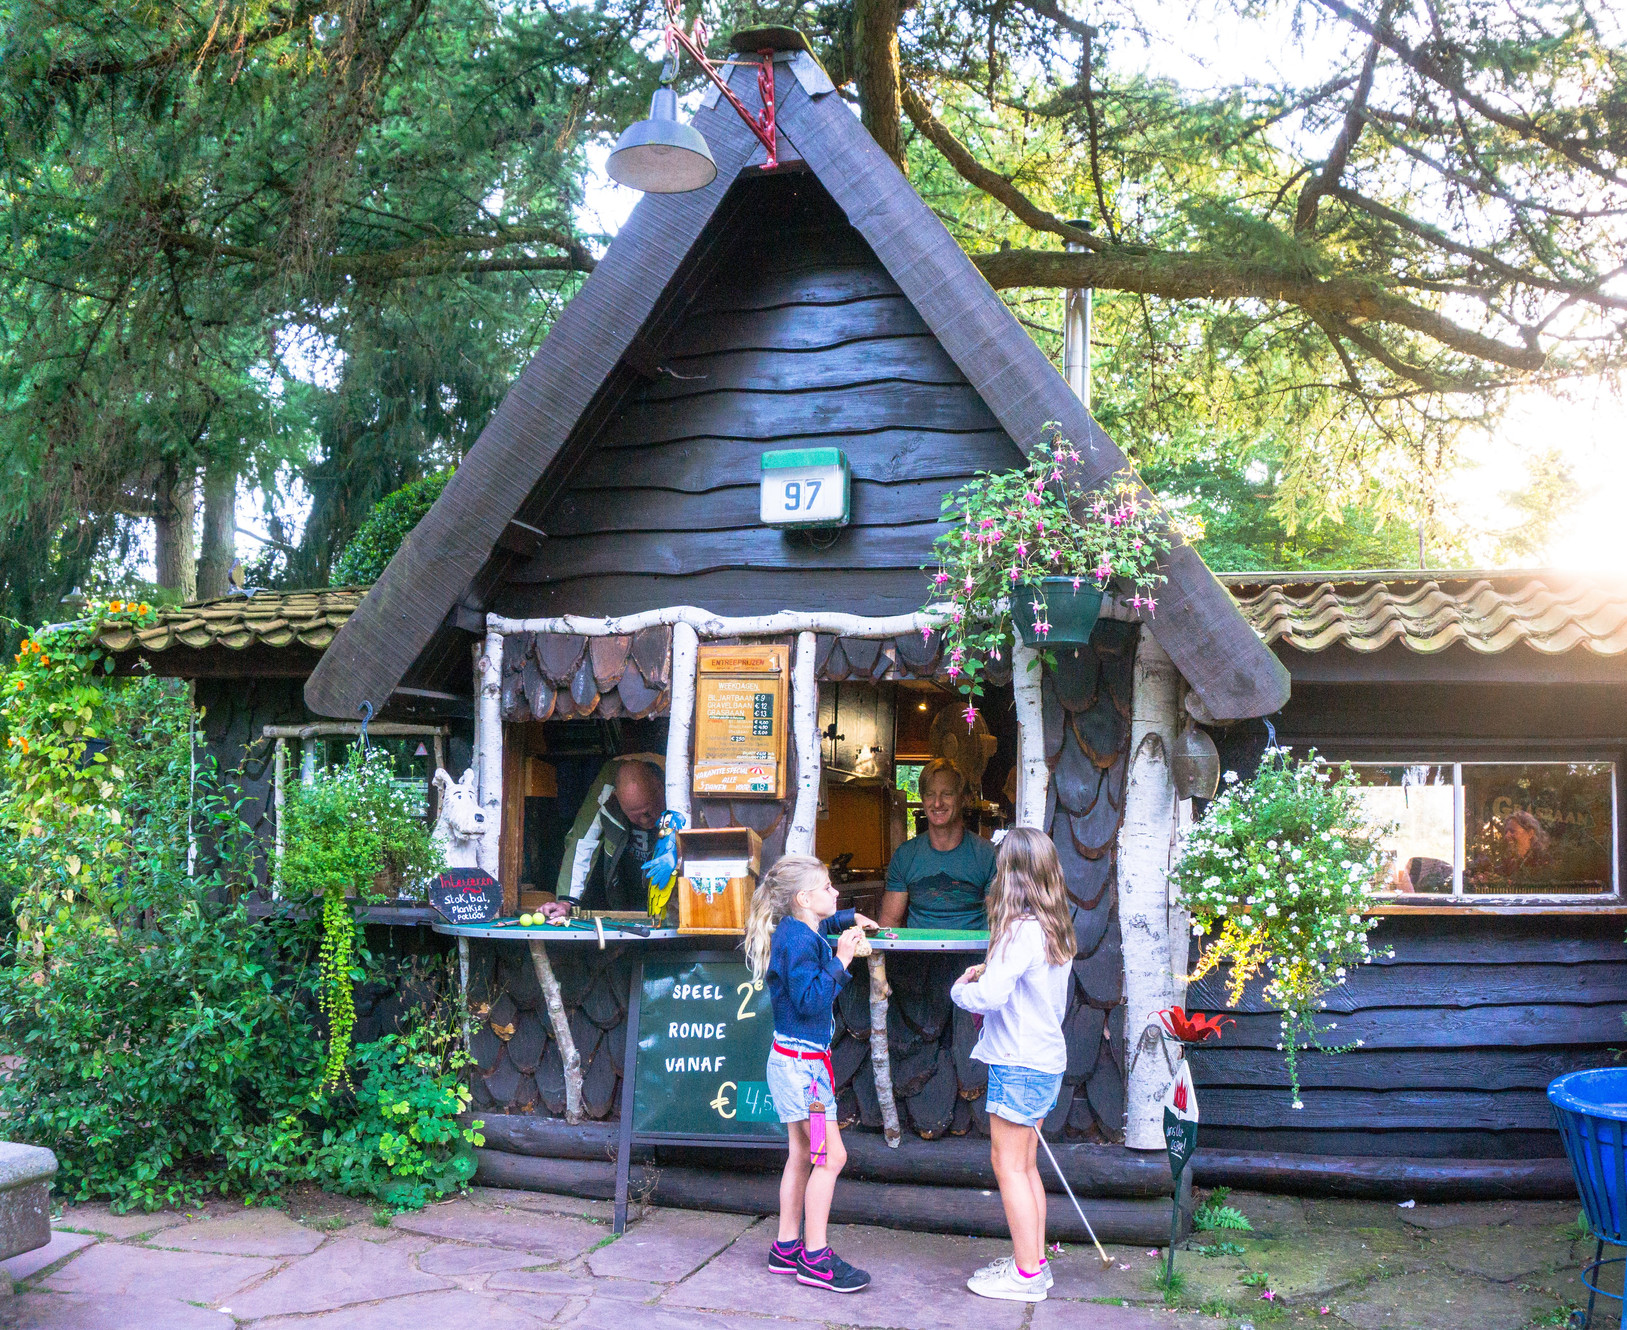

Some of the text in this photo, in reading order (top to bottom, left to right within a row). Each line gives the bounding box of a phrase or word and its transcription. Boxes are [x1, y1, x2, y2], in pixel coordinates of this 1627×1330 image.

[785, 481, 822, 511] 97
[712, 658, 765, 666] ENTREEPRIJZEN
[718, 682, 759, 690] WEEKDAGEN
[672, 984, 723, 1000] SPEEL
[668, 1022, 727, 1040] RONDE
[665, 1056, 726, 1073] VANAF
